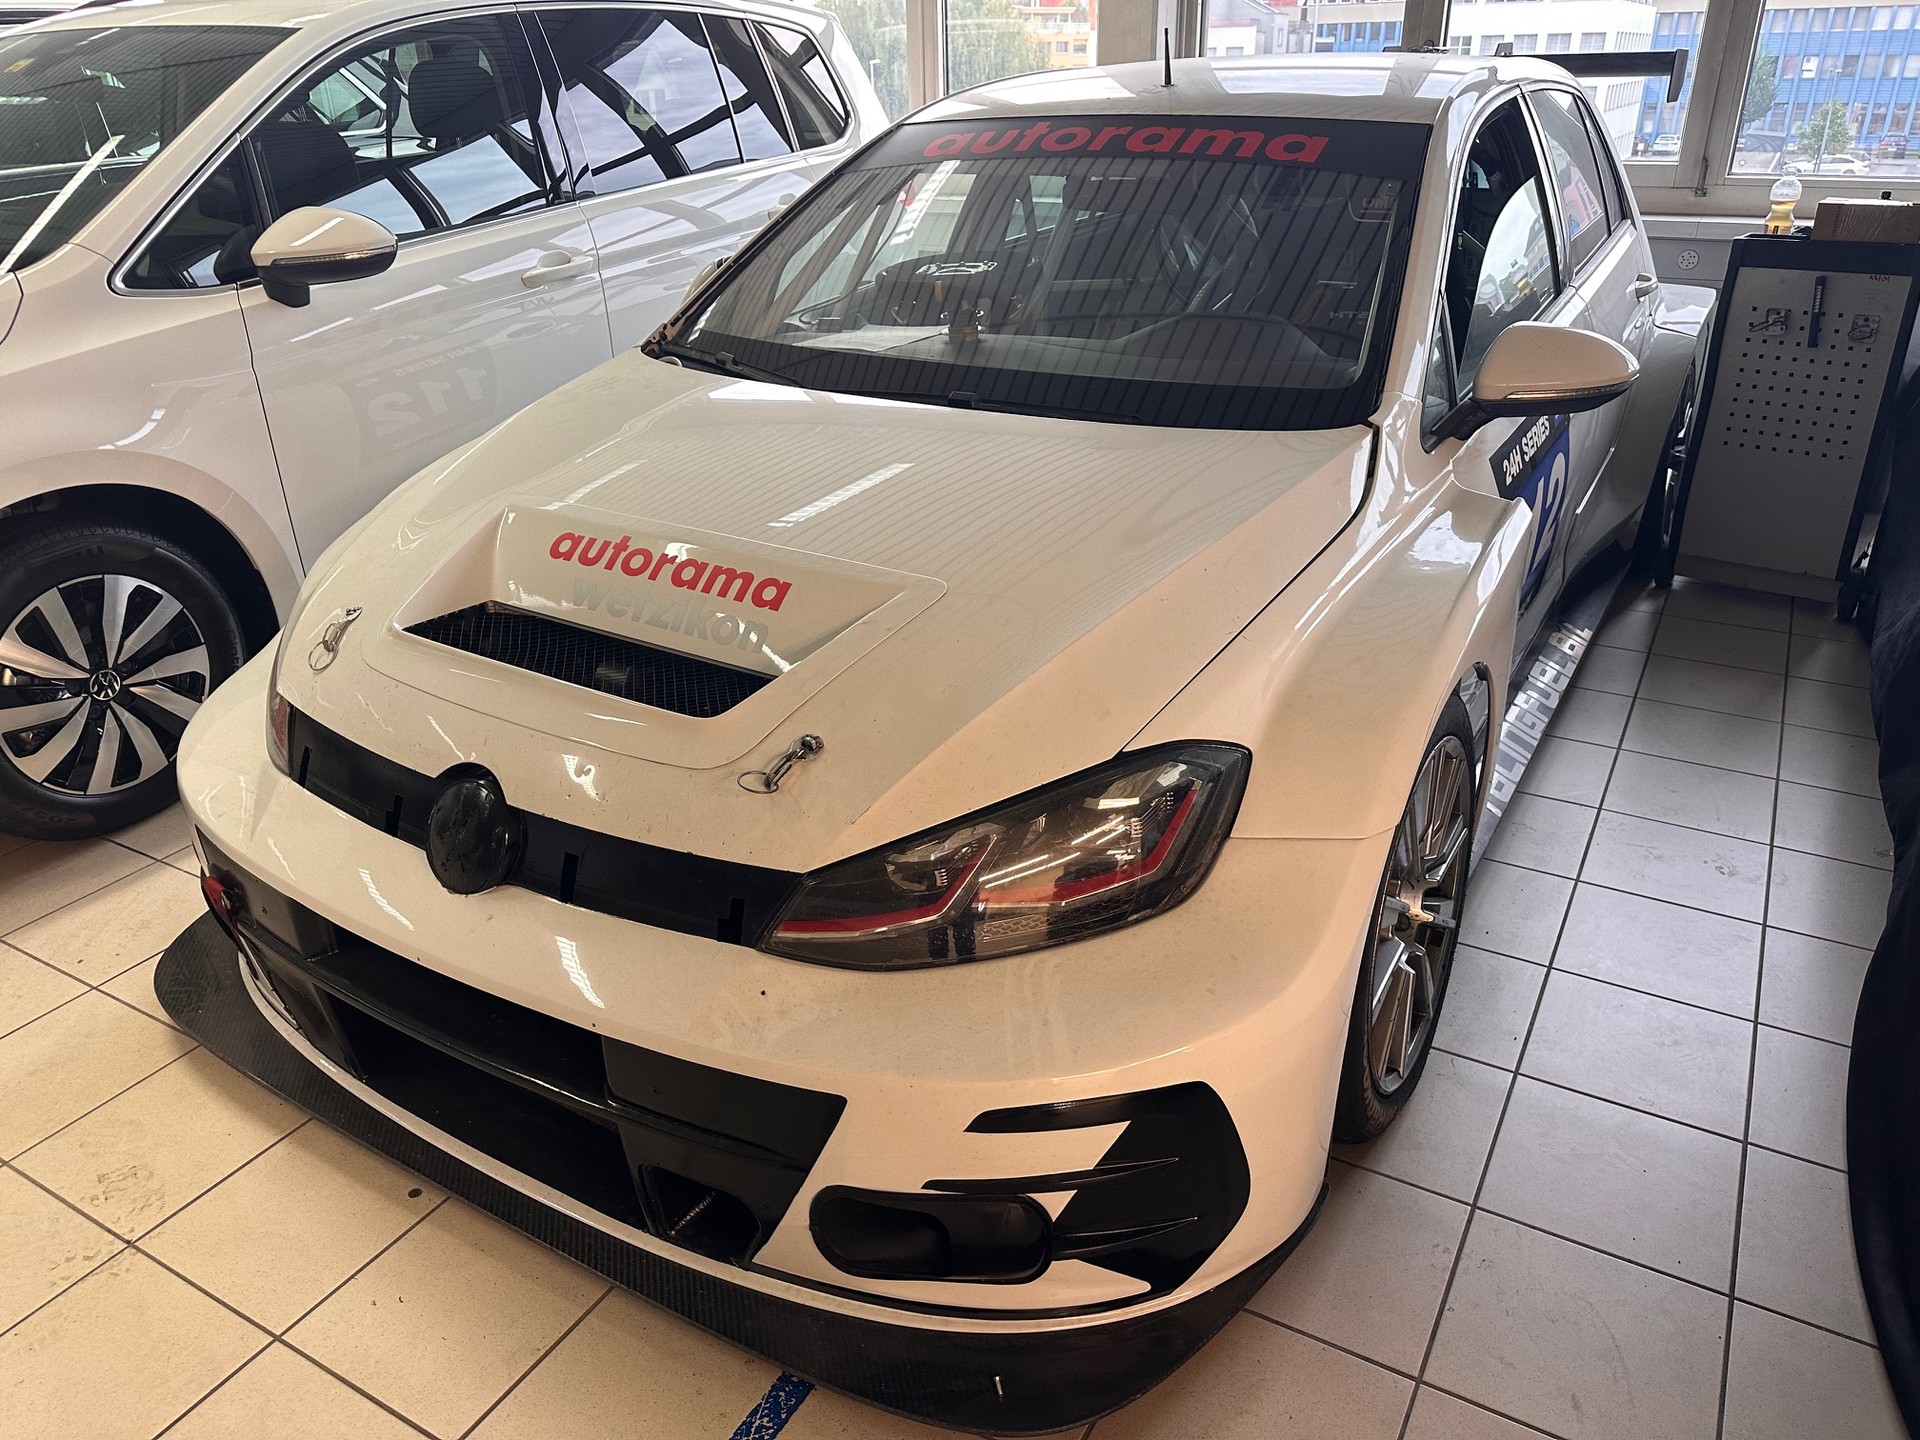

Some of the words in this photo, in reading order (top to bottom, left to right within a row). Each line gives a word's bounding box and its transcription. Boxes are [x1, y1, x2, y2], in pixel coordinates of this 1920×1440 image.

[923, 121, 1330, 163] autorama
[1502, 445, 1523, 487] 24H
[1521, 415, 1550, 463] SERIES
[549, 531, 793, 612] autorama
[572, 576, 769, 655] wetzikon
